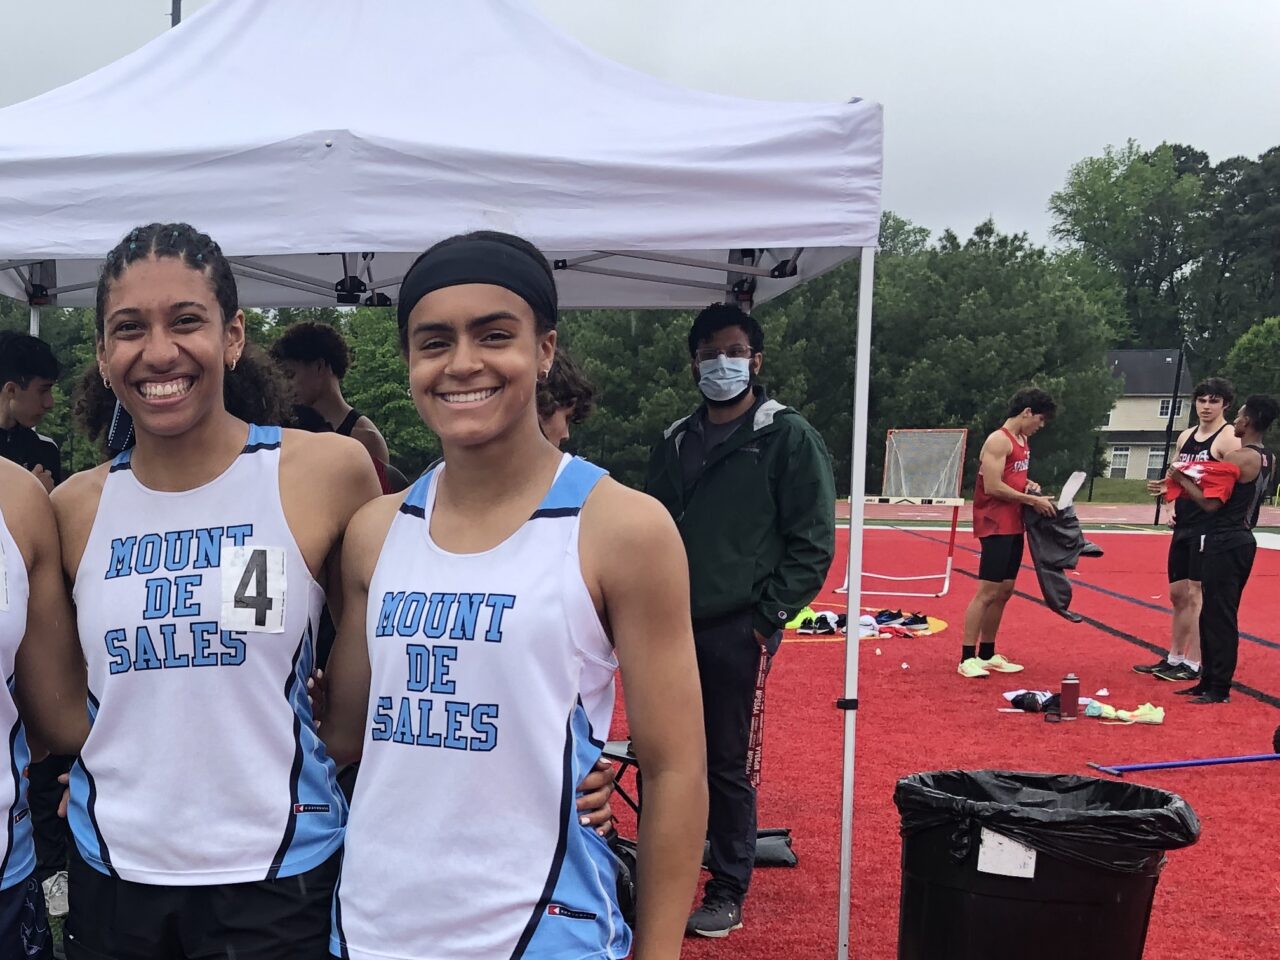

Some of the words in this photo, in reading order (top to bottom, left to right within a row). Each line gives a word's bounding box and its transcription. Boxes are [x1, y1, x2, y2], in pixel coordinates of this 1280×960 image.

[142, 574, 203, 620] DE
[233, 549, 273, 627] 4
[376, 590, 516, 644] MOUNT
[104, 621, 247, 675] SALES
[406, 644, 458, 695] DE
[372, 696, 500, 753] SALES
